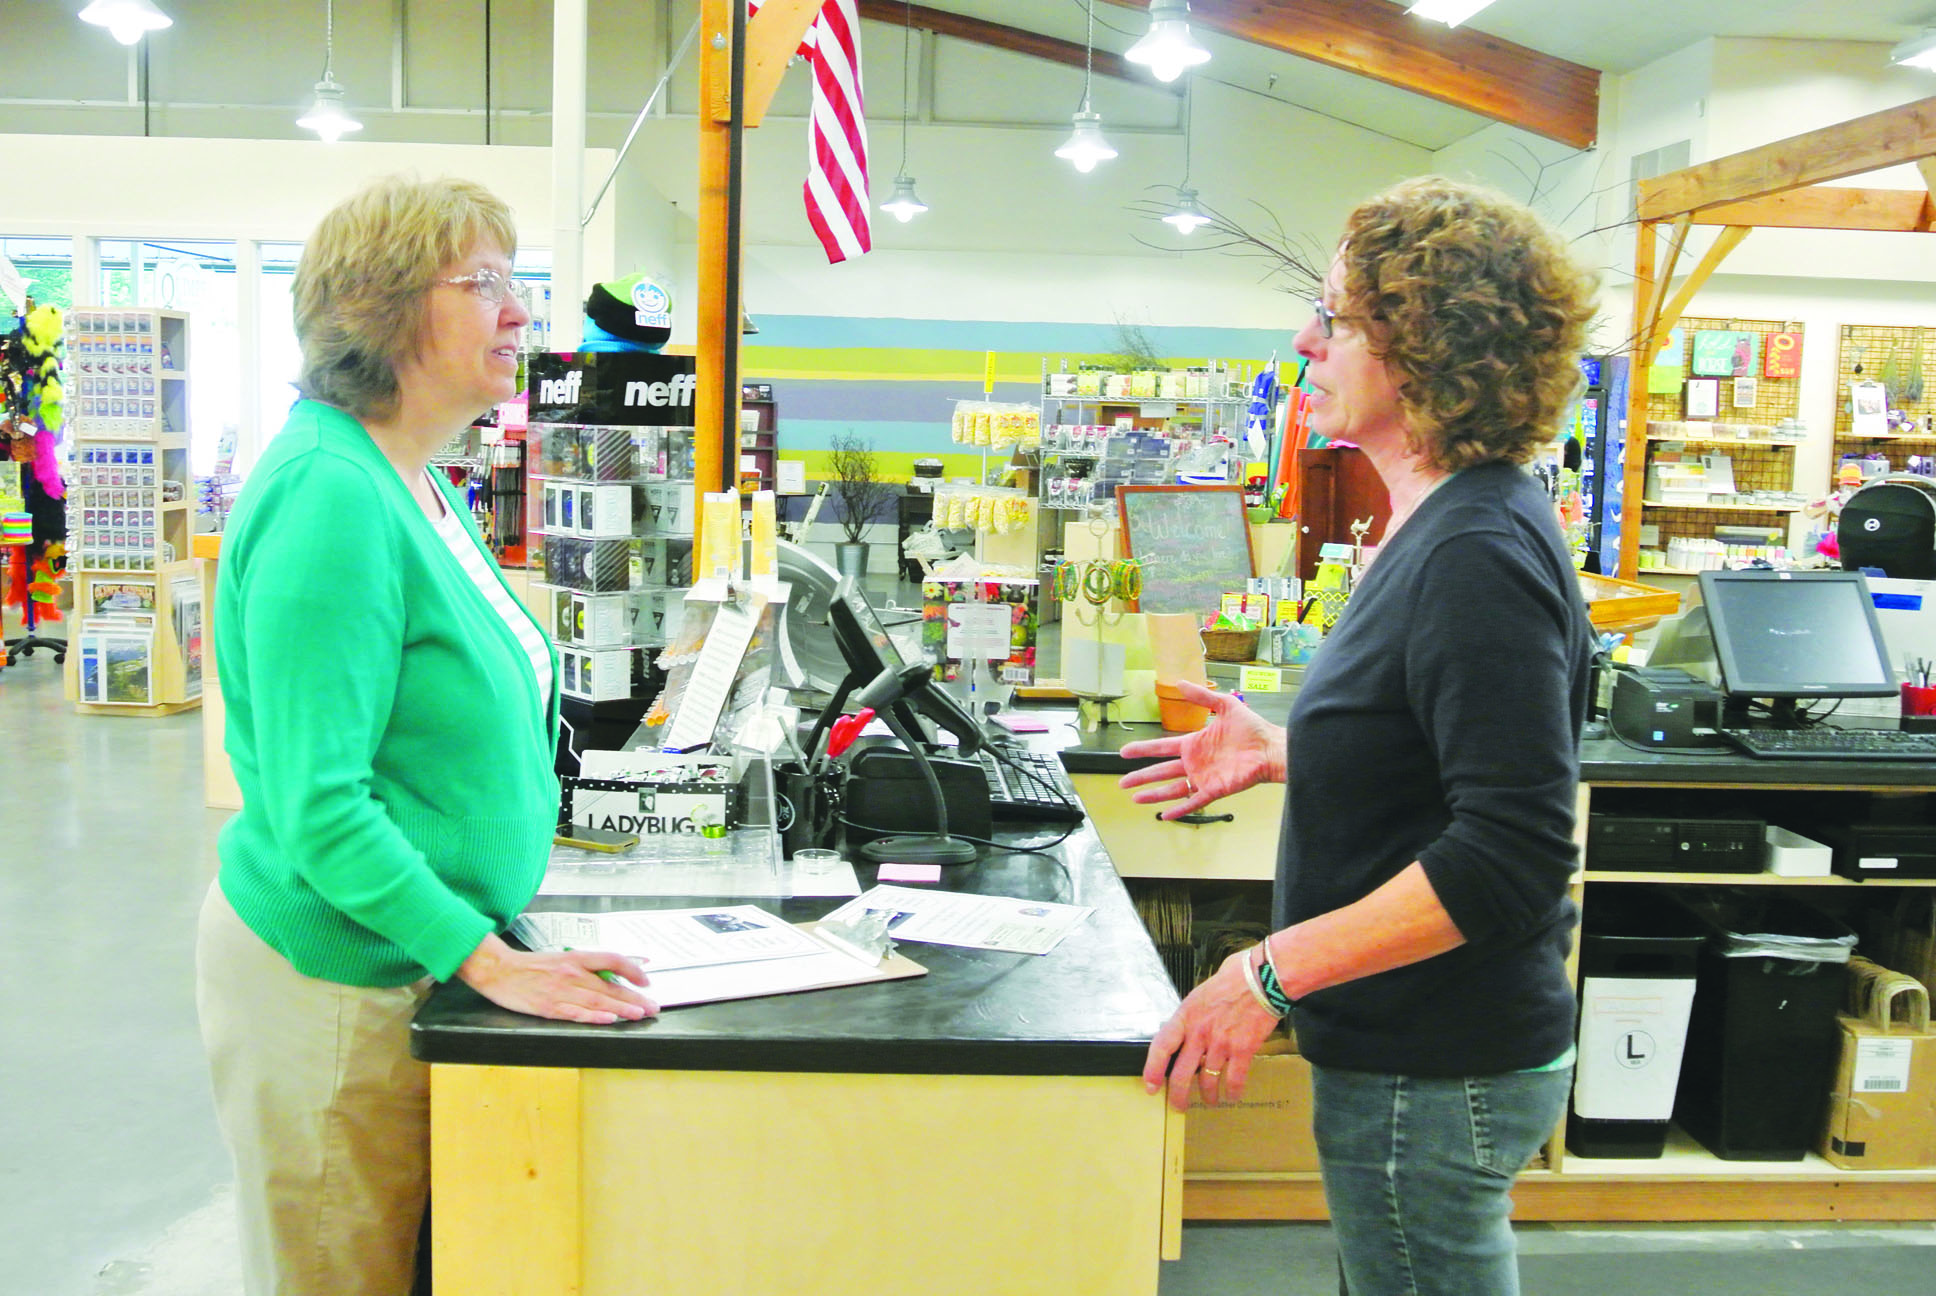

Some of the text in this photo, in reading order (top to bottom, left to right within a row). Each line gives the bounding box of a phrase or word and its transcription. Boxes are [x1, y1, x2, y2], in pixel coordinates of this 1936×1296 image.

[638, 313, 668, 326] neff
[539, 370, 583, 405] neff
[623, 374, 696, 407] neff
[1627, 1034, 1646, 1059] L
